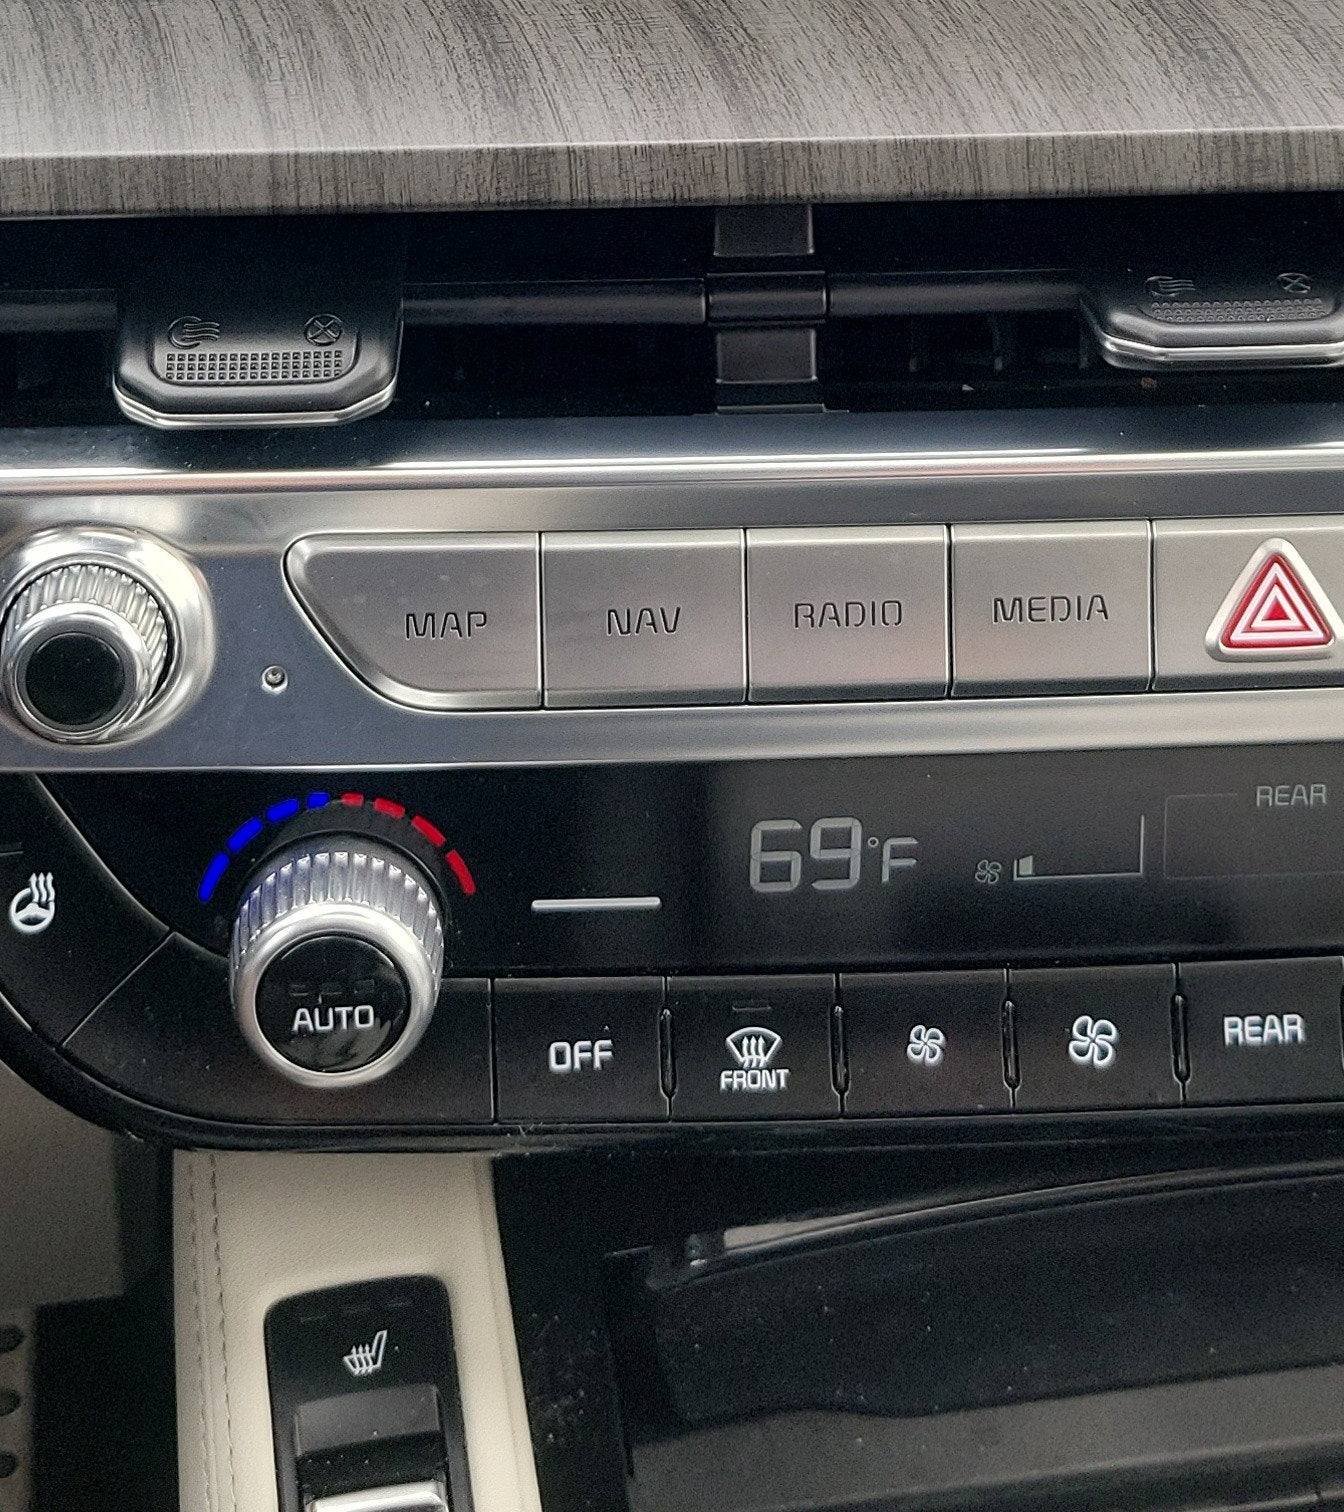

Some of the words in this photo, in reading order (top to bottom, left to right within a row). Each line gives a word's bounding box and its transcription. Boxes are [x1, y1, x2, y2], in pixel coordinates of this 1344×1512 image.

[606, 605, 681, 636] NAV
[793, 599, 904, 629] RADIO
[992, 593, 1110, 624] MEDIA
[404, 610, 488, 641] MAP
[1255, 783, 1327, 807] REAR
[292, 1005, 375, 1033] AUTO
[1223, 1013, 1305, 1046] REAR
[548, 1040, 614, 1072] OFF
[719, 1067, 790, 1091] FRONT
